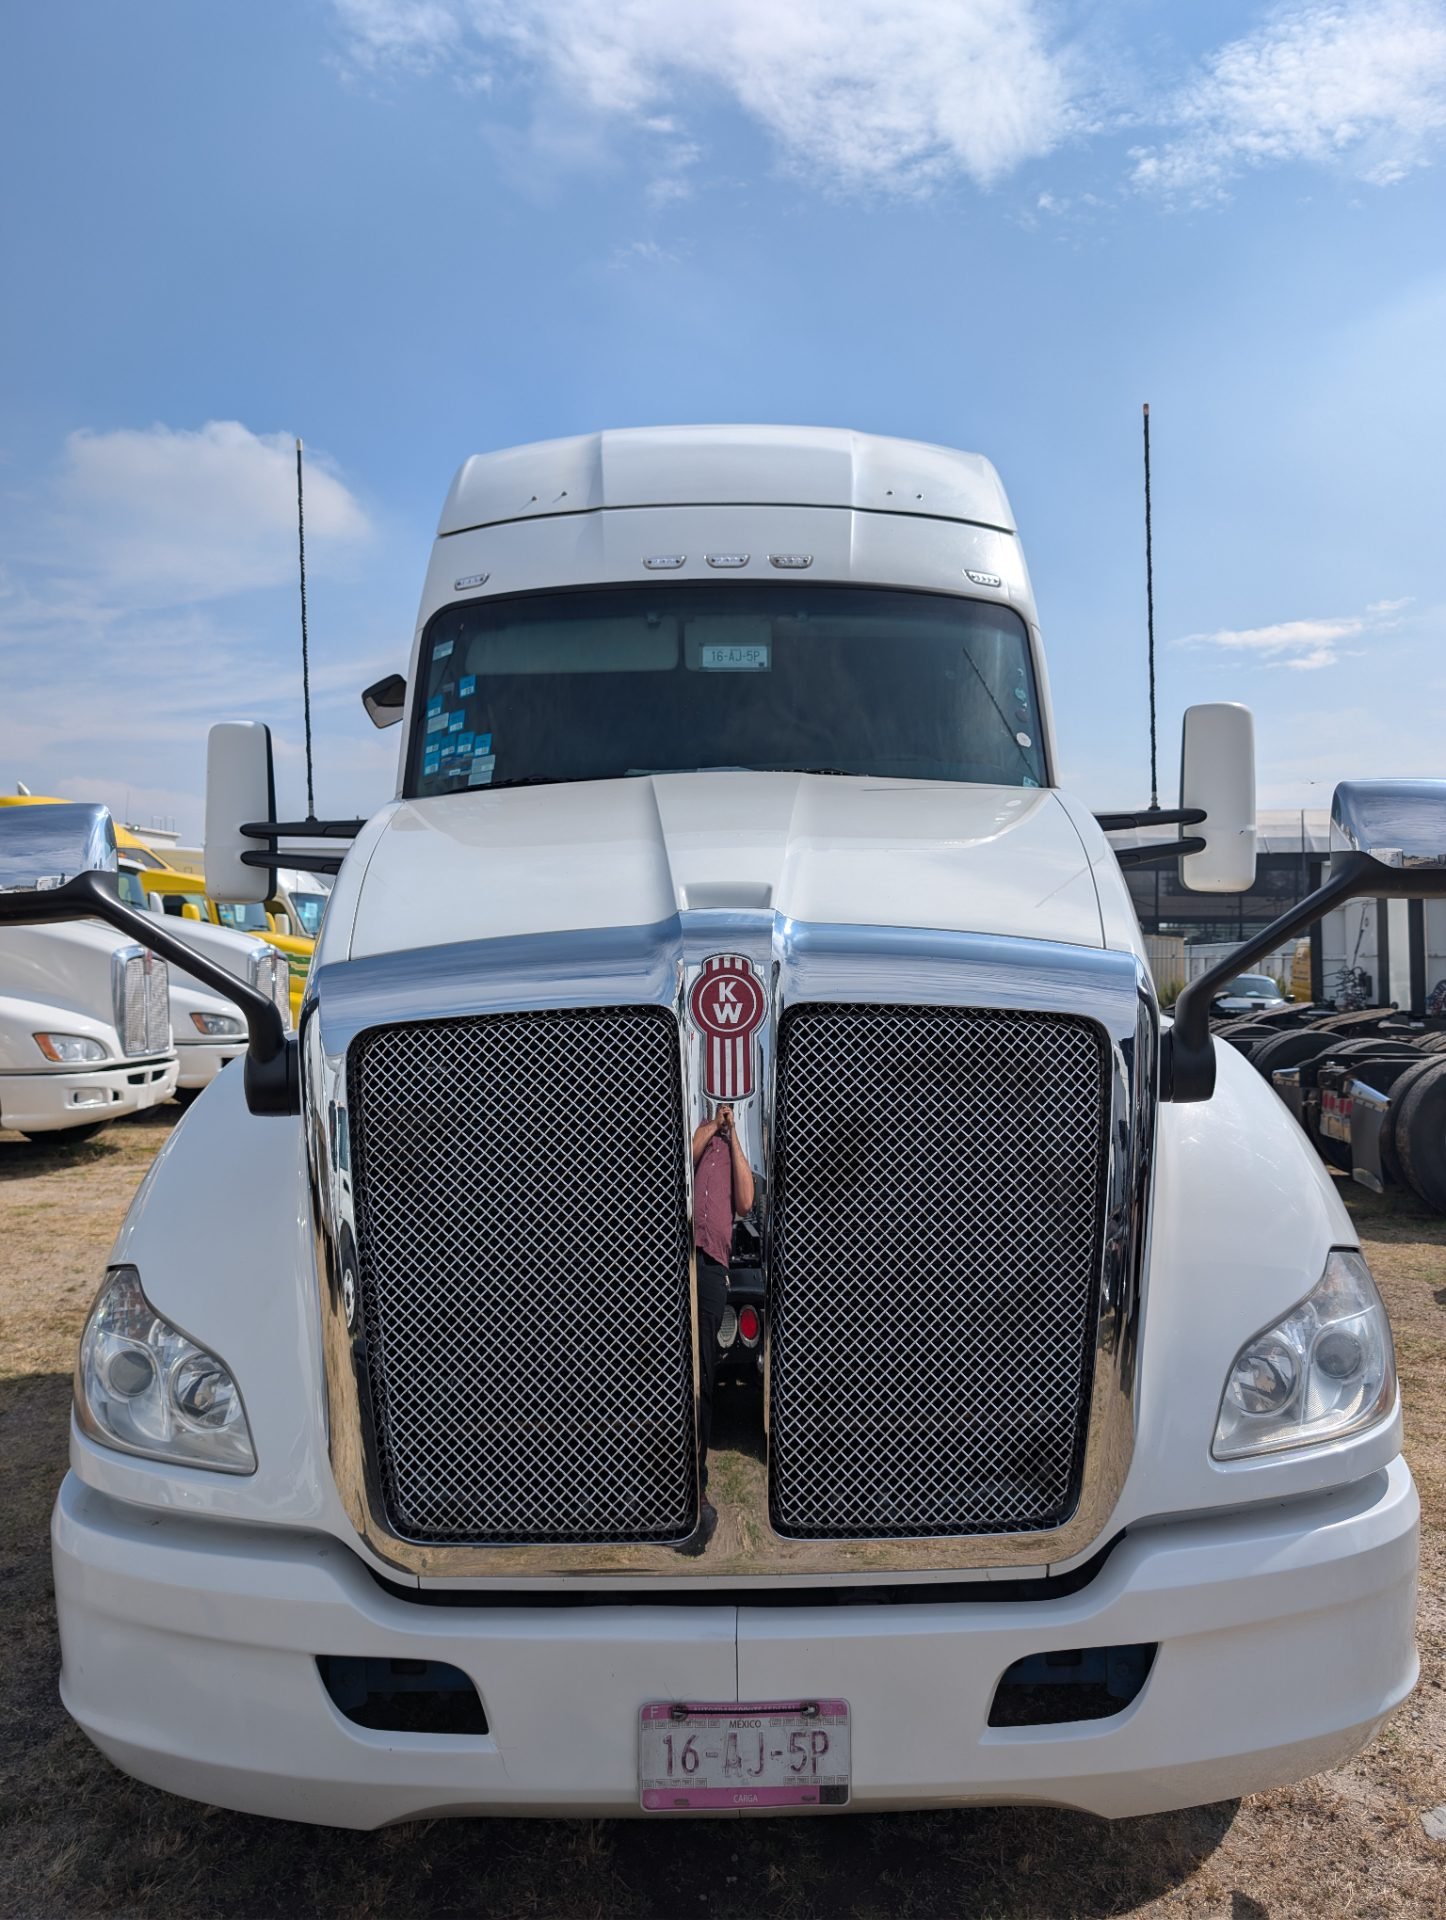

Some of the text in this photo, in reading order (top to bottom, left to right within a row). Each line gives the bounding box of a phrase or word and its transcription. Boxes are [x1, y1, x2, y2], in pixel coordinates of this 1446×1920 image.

[711, 650, 761, 663] 16-AJ-5P
[662, 1730, 830, 1777] 16-AJ-5P
[733, 1793, 759, 1804] CARGA
